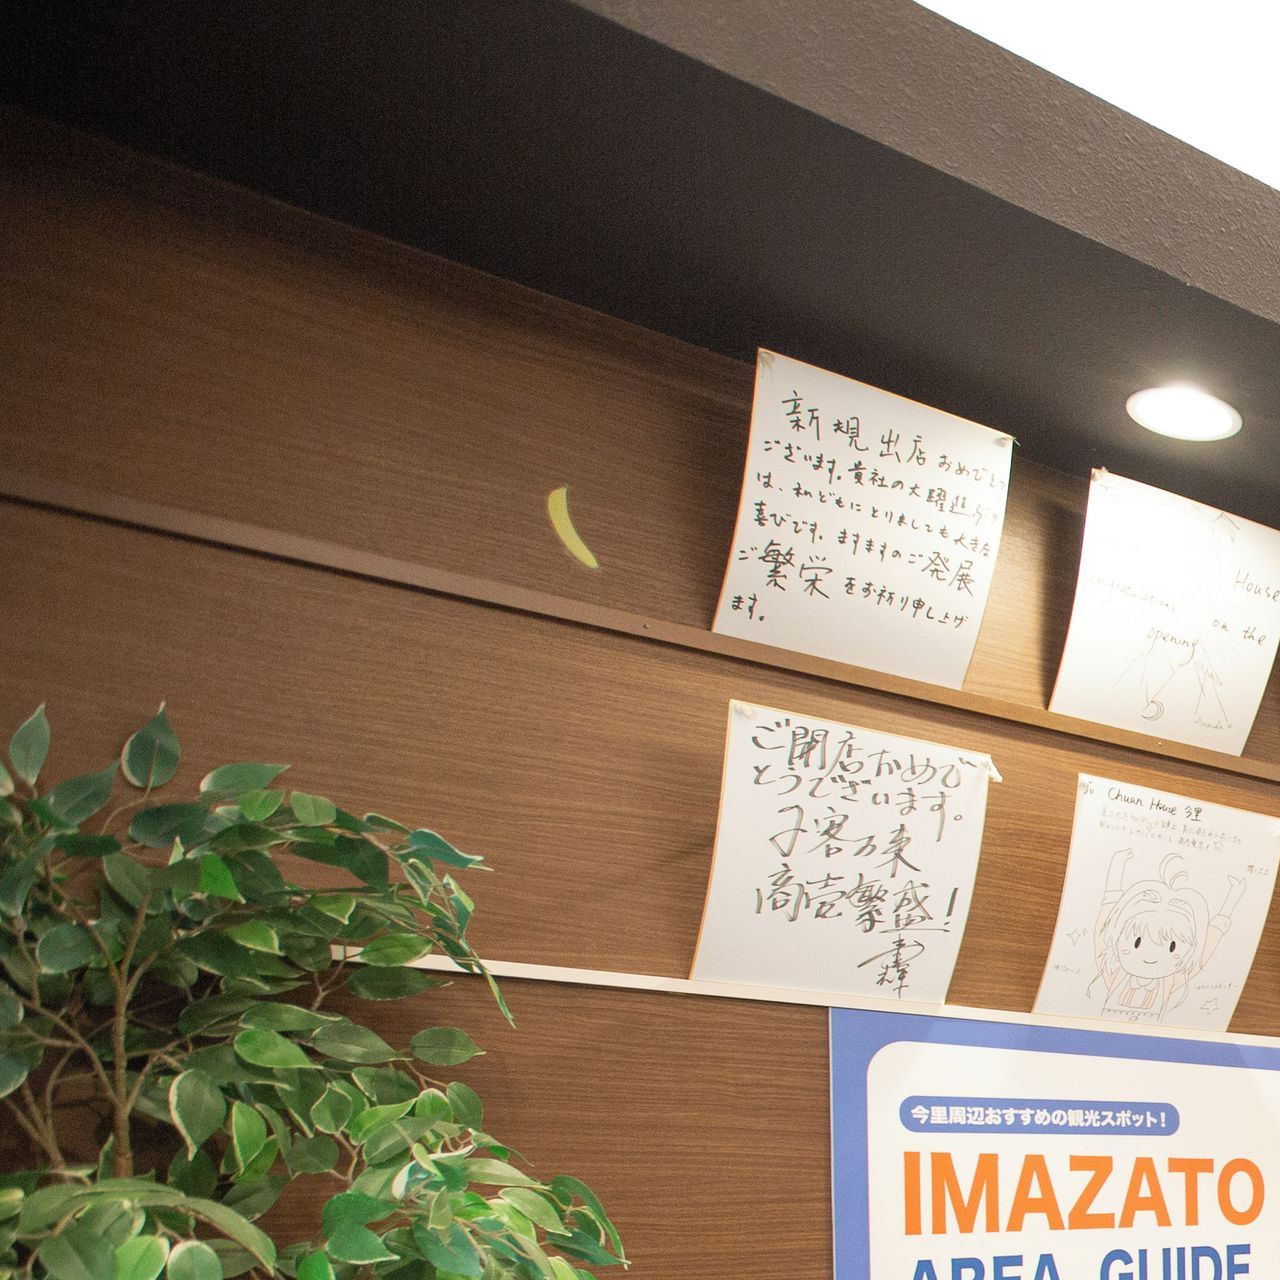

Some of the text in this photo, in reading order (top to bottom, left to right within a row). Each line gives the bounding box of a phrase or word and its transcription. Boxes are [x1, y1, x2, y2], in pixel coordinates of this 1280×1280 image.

[1235, 569, 1280, 602] House
[1242, 626, 1267, 647] the
[1107, 785, 1143, 807] Chuan
[1150, 797, 1178, 816] House
[903, 1150, 1266, 1237] IMAZATO
